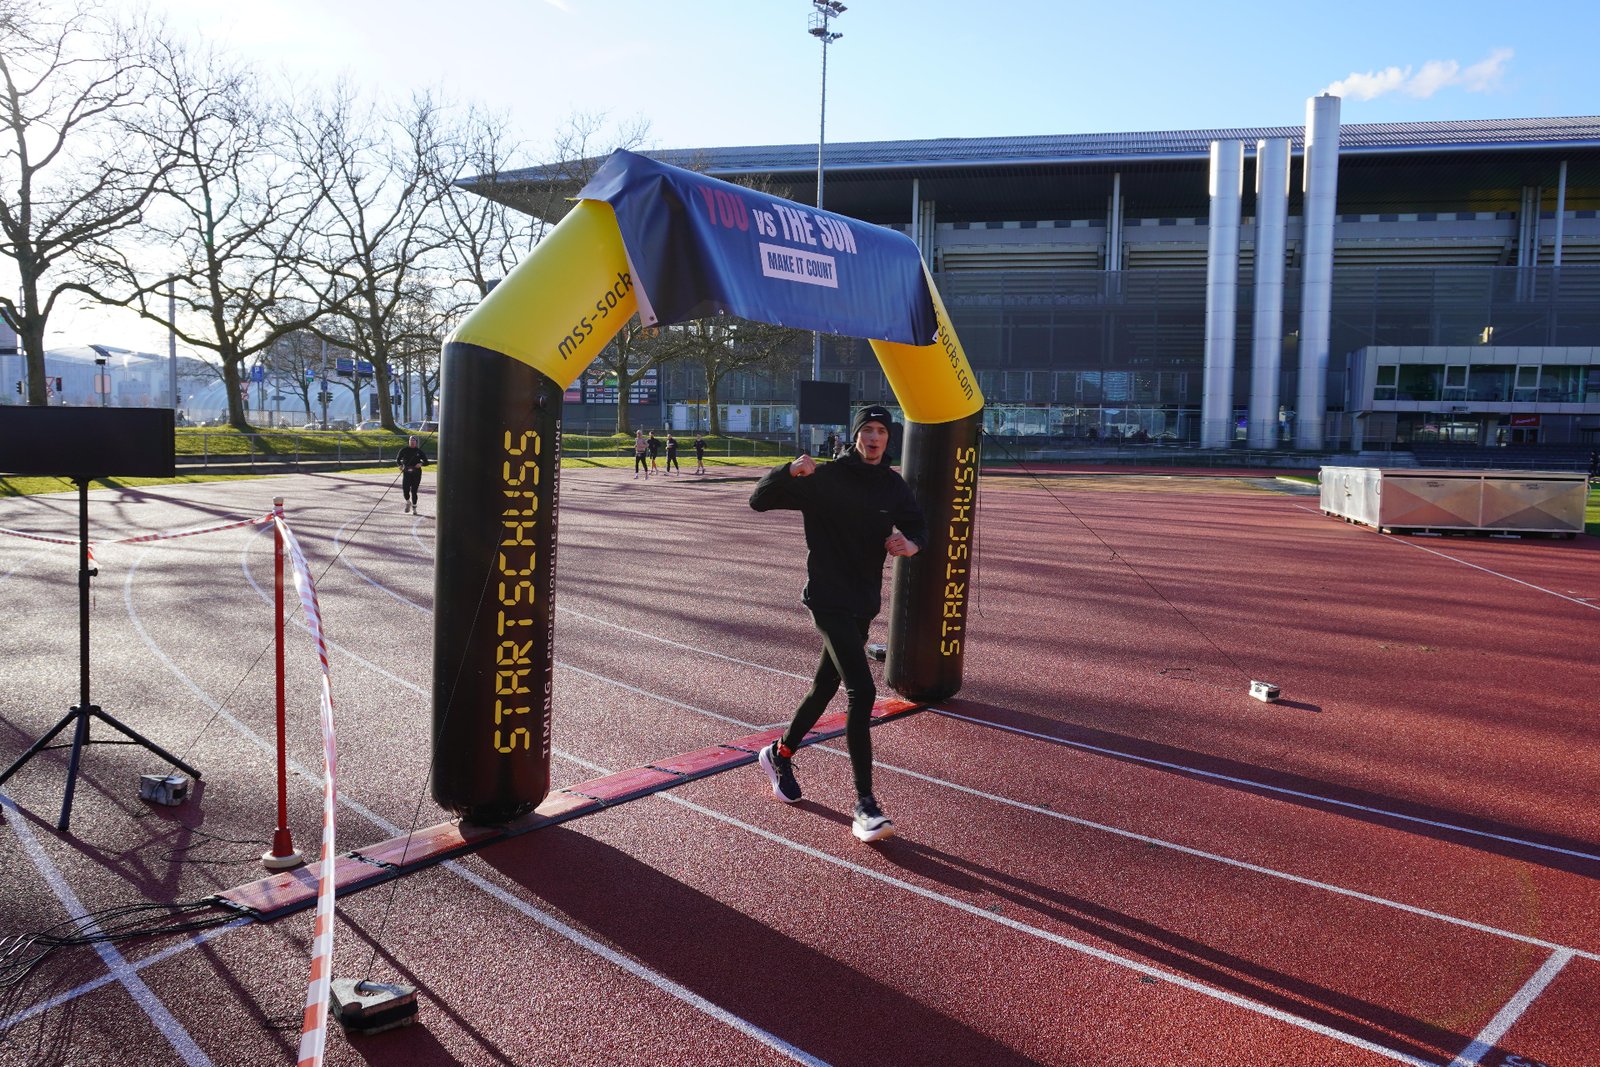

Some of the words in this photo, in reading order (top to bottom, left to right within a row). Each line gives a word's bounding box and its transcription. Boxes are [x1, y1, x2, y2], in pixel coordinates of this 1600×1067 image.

[699, 184, 749, 232] YOU
[772, 203, 817, 246] THE
[814, 214, 857, 254] SUN
[767, 251, 795, 273] MAKE
[795, 257, 804, 275] IT
[806, 259, 833, 280] COUNT
[551, 419, 561, 526] ZEITMESSUNG
[494, 430, 541, 754] STARTSCHUSS
[547, 532, 557, 659] PROFESSIONELLE
[940, 447, 976, 656] STARTSCHUSS
[542, 682, 551, 759] TIMING
